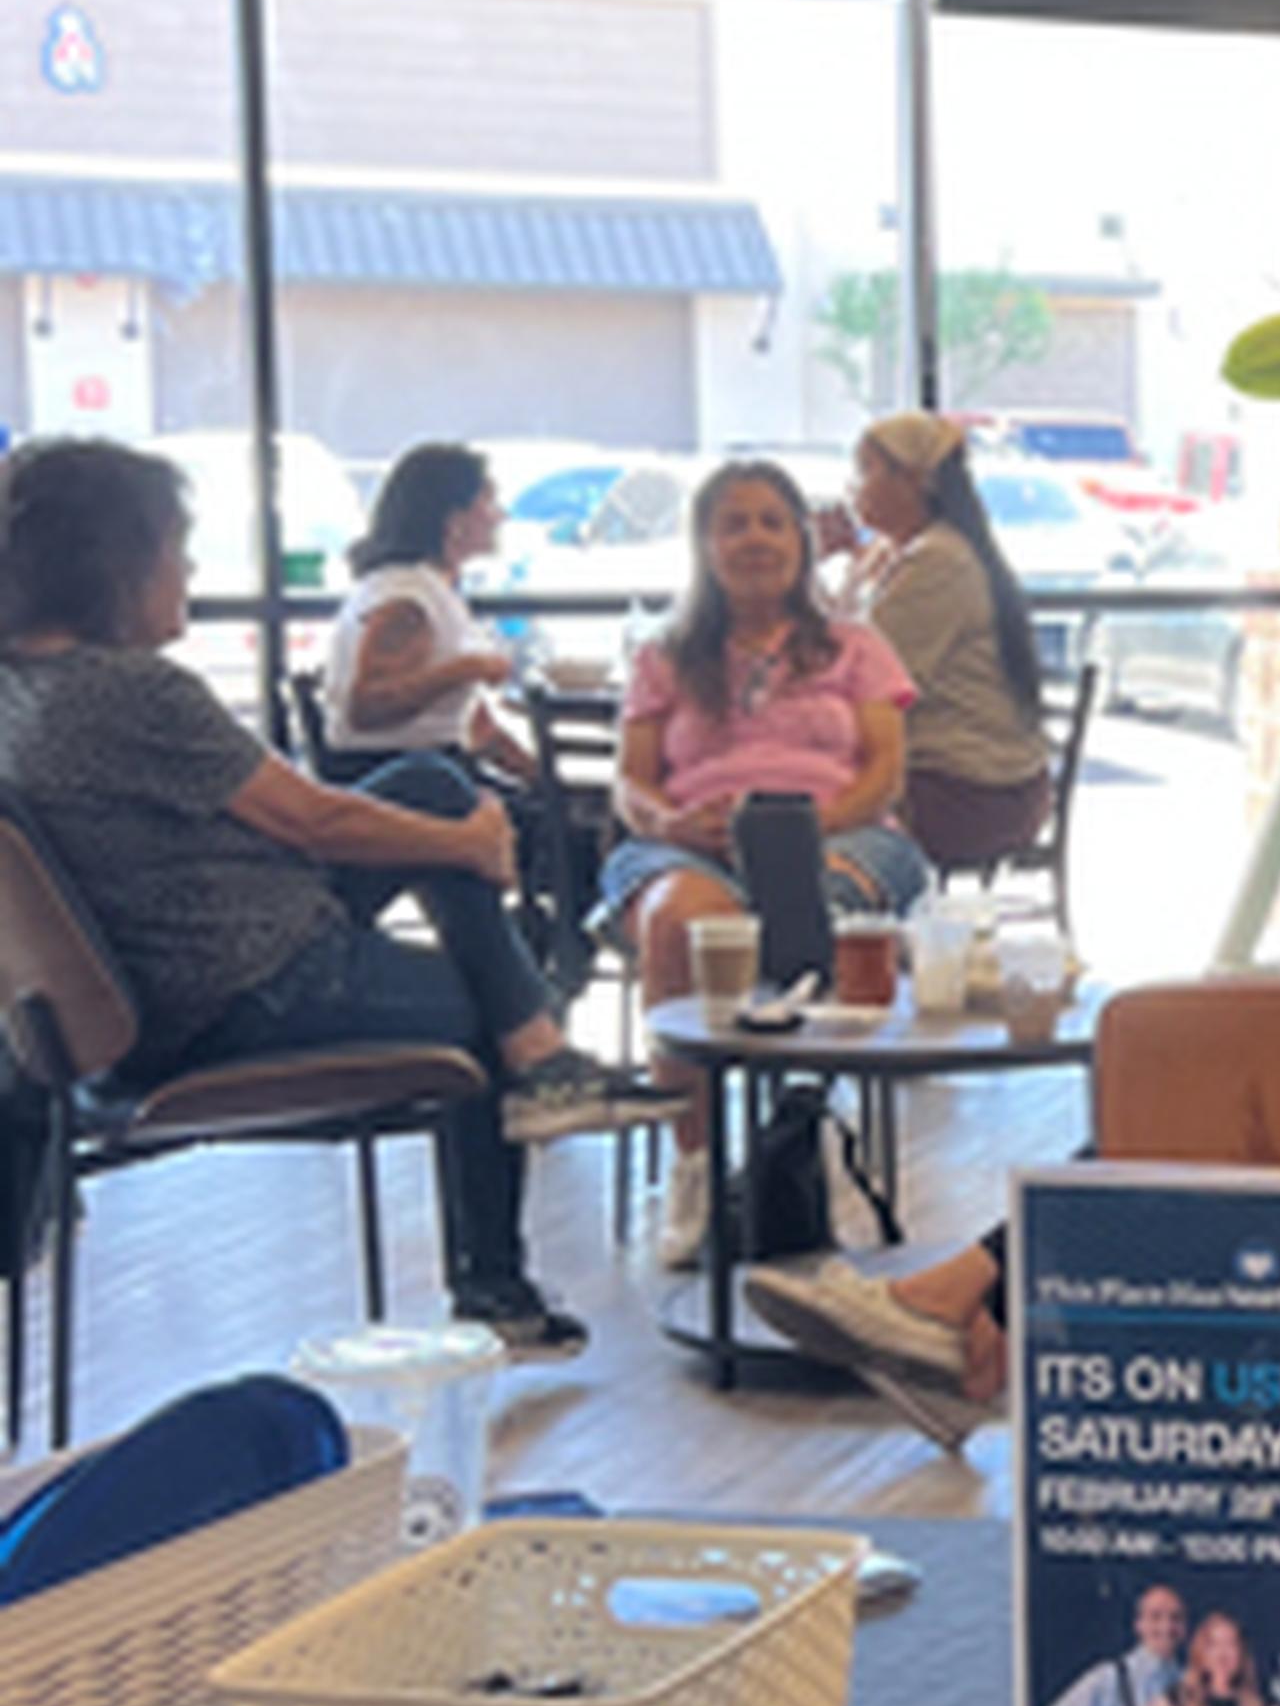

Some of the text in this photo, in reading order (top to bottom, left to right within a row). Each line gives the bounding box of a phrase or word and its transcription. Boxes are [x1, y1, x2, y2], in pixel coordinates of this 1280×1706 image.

[1035, 1276, 1091, 1304] This
[1098, 1277, 1164, 1307] Place
[1037, 1354, 1115, 1401] ITS
[1123, 1354, 1202, 1402] ON
[1037, 1475, 1221, 1516] FEBRUARY
